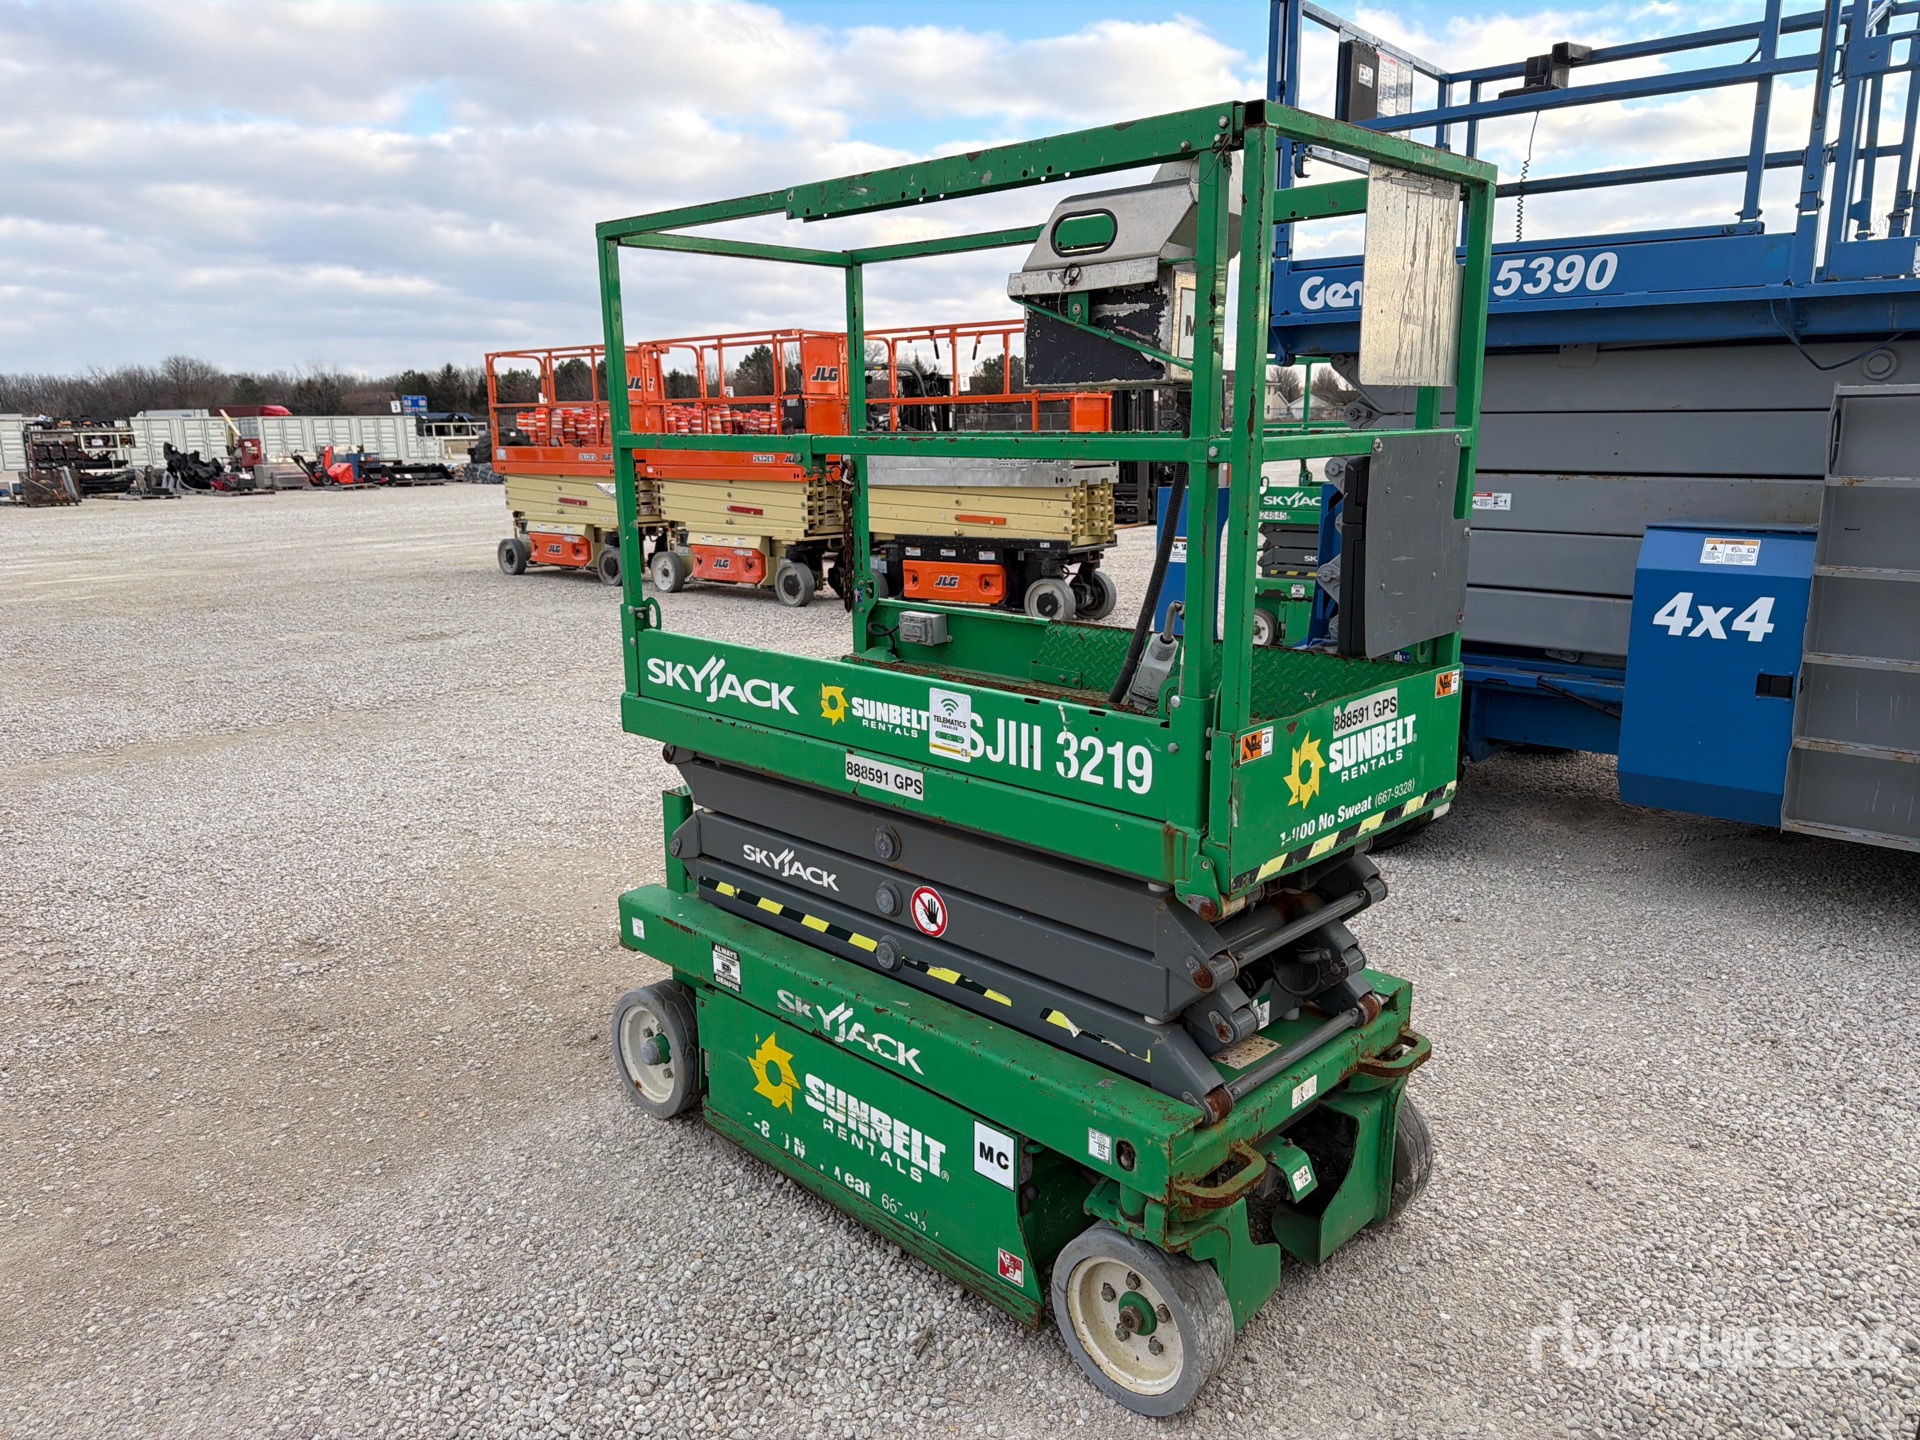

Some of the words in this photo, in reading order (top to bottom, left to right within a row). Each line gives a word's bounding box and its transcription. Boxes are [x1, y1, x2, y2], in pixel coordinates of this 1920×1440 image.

[1299, 275, 1363, 310] Gen
[1493, 252, 1619, 297] 5390
[1185, 315, 1195, 336] M
[811, 366, 838, 382] JLG
[753, 454, 775, 463] 2632ES
[784, 455, 796, 463] JL
[1263, 491, 1322, 508] SKYJAC
[547, 544, 561, 554] JLG
[713, 557, 730, 569] JLG
[934, 575, 960, 588] JLG
[1652, 591, 1776, 642] 4x4
[646, 654, 799, 715] SKYJACK
[851, 696, 929, 731] SUNBELT
[862, 719, 918, 738] RENTALS
[933, 714, 967, 729] TELEMATICS
[941, 723, 959, 732] ENABLED
[1333, 704, 1369, 733] 888591
[1373, 696, 1397, 718] GPS
[1328, 713, 1417, 774] SUNBELT
[846, 761, 889, 786] 888591
[894, 773, 923, 796] GPS
[1056, 730, 1153, 795] 3219
[1341, 748, 1403, 783] RENTALS
[1318, 812, 1335, 832] No
[1337, 795, 1373, 823] Sweat
[1374, 777, 1416, 808] (667-9328)
[742, 847, 840, 892] SKYJACK
[714, 943, 738, 960] ALWAYS
[715, 974, 740, 993] SIEMPRE
[776, 989, 925, 1076] SKYJACK
[806, 1073, 946, 1177] SUNBELT
[823, 1118, 923, 1184] RENTALS
[979, 1141, 1010, 1171] MC
